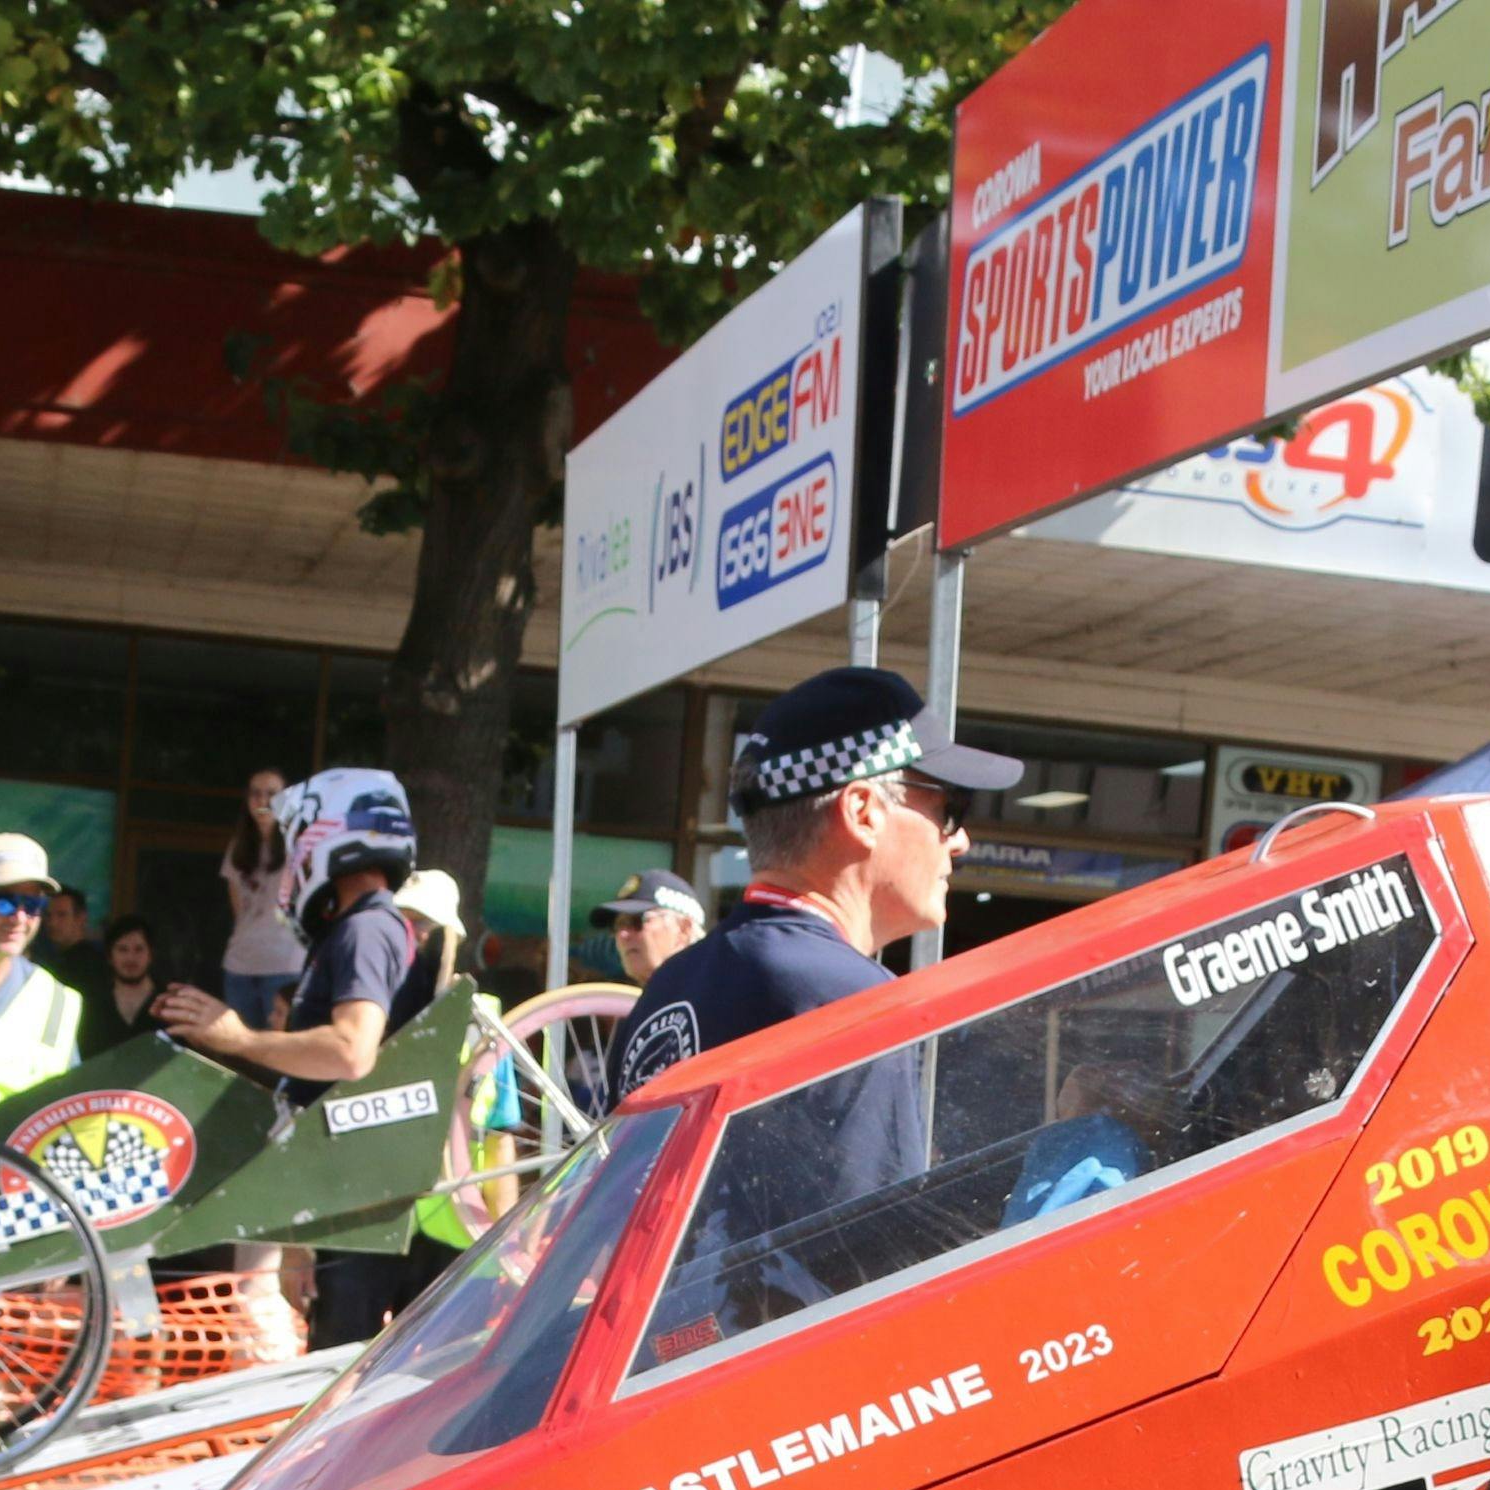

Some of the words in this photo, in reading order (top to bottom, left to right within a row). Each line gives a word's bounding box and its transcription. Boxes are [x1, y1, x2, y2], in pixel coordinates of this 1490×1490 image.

[971, 141, 1041, 230] COROWA
[960, 77, 1257, 396] SPORTSPOWER
[1084, 349, 1123, 401] YOUR
[1121, 324, 1170, 382] LOCAL
[1170, 286, 1244, 364] EXPERTS
[723, 373, 789, 474] EDGE
[792, 336, 842, 442] FM
[719, 507, 770, 591] 1566
[776, 477, 828, 560] 3NE
[1259, 766, 1341, 799] VHT
[1162, 911, 1309, 1007] Graeme
[1300, 863, 1415, 954] Smith
[331, 1097, 391, 1127] COR
[398, 1088, 432, 1115] 19
[1364, 1125, 1490, 1206] 2019
[1018, 1323, 1115, 1384] 2023
